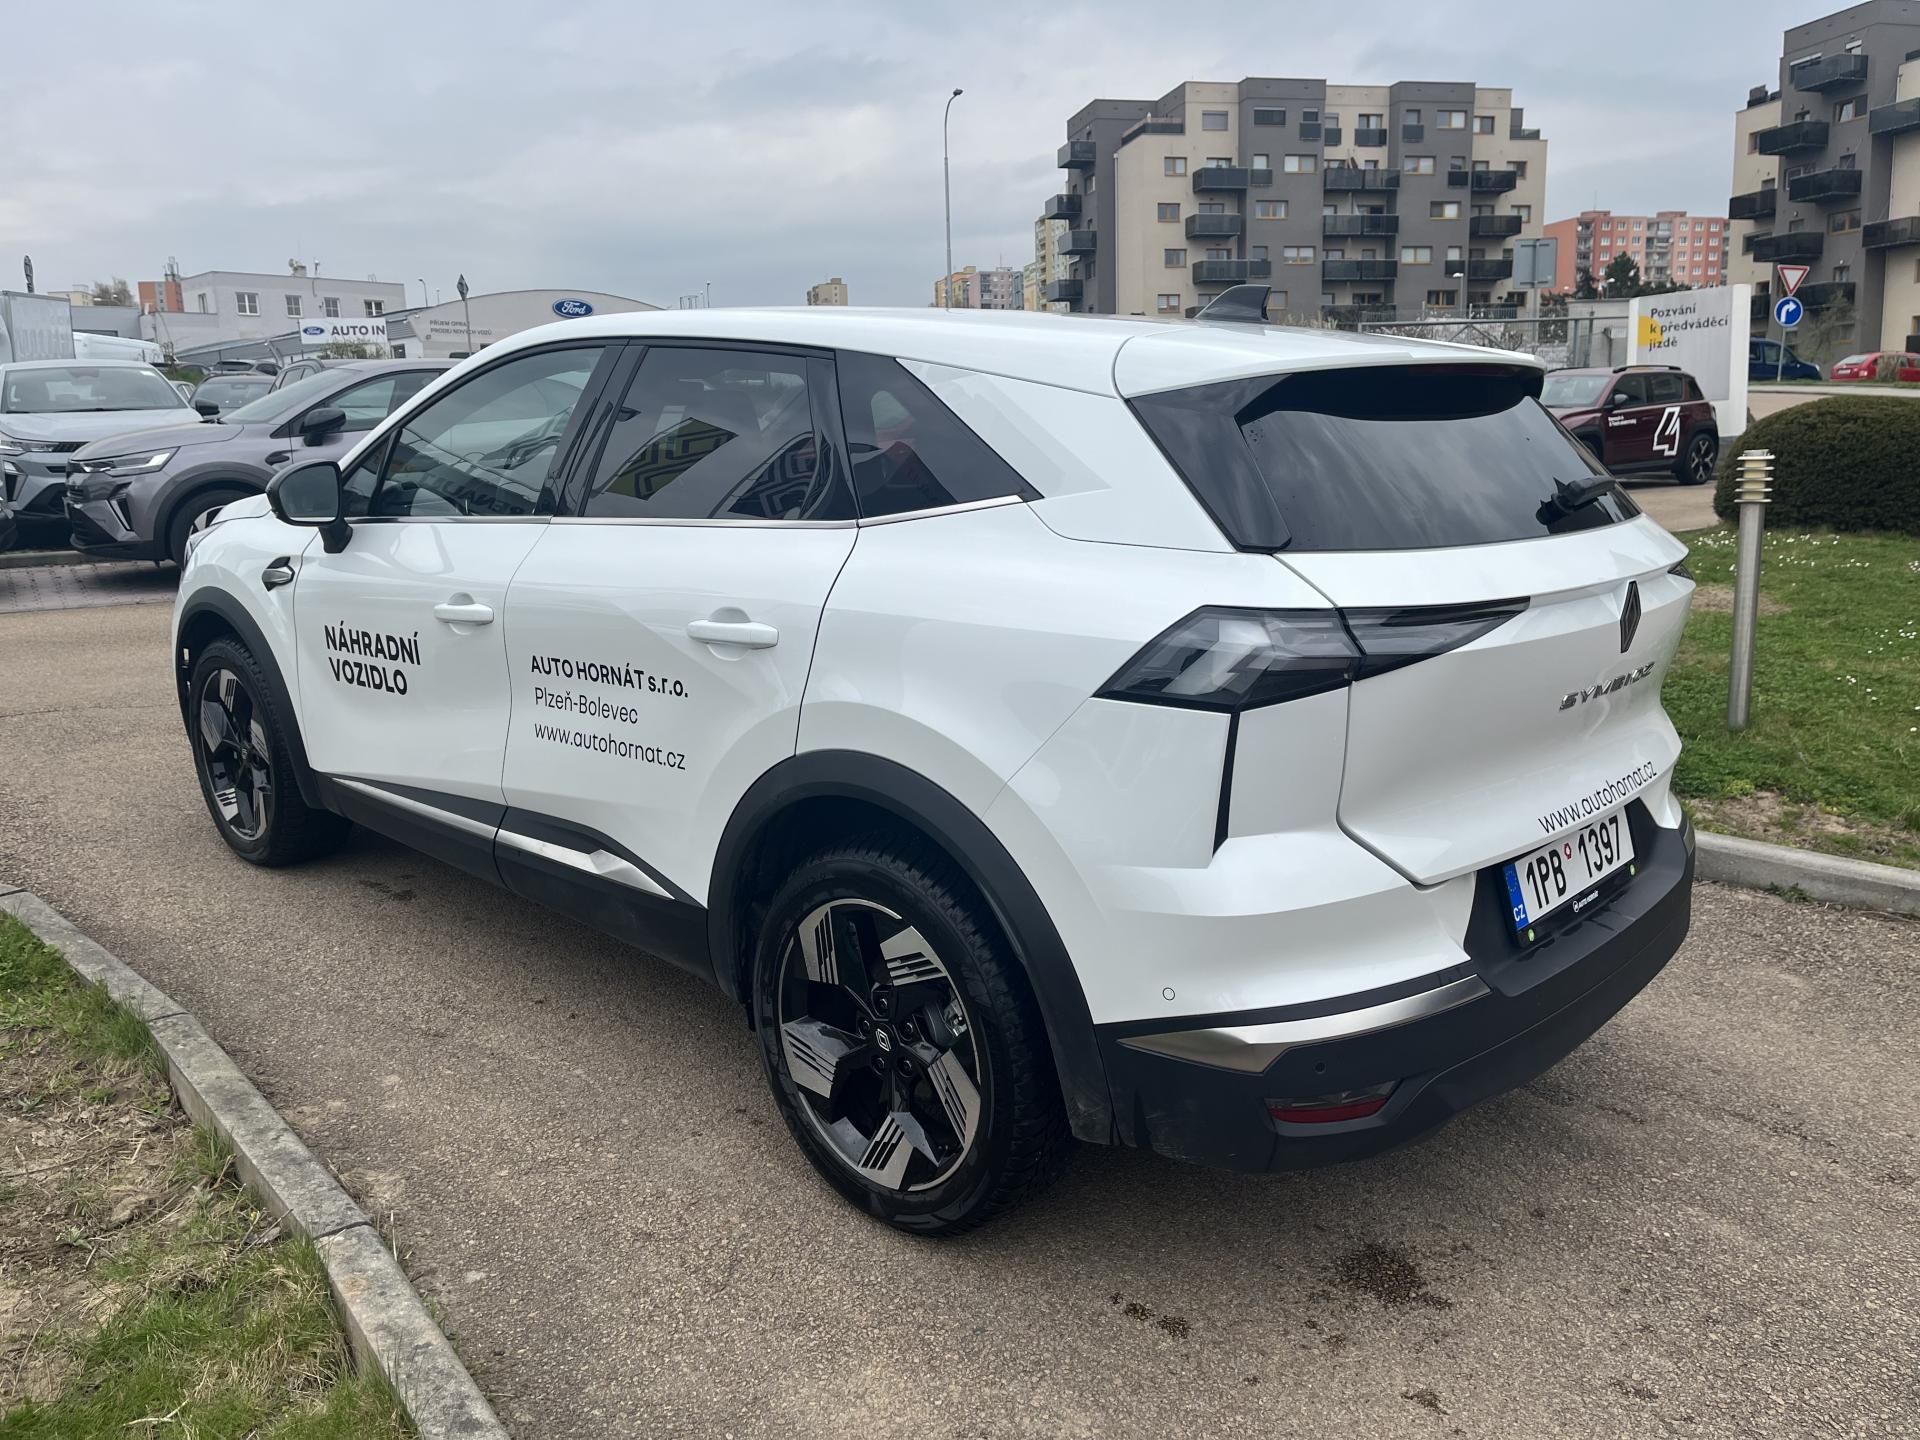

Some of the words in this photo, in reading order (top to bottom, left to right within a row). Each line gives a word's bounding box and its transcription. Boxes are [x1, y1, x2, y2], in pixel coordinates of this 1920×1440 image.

[561, 301, 586, 315] Ford
[1649, 324, 1656, 334] k
[1660, 315, 1729, 335] předváděcí
[1650, 303, 1697, 318] Pozvání
[331, 325, 369, 336] AUTO
[371, 325, 386, 336] IN
[1649, 337, 1678, 351] jízdě
[1652, 406, 1681, 456] 4
[324, 620, 421, 665] NÁHRADNÍ
[328, 656, 408, 695] VOZIDLO
[531, 655, 573, 678] AUTO
[576, 662, 644, 690] HORNÁT
[648, 675, 688, 698] s.r.o.
[534, 686, 638, 725] Plzeň-Bolevec
[534, 723, 686, 770] www.autohornat.cz
[1538, 761, 1657, 834] www.autohornat.cz
[1526, 849, 1567, 909] 1PB
[1578, 814, 1620, 878] 1397
[1513, 903, 1526, 922] CZ
